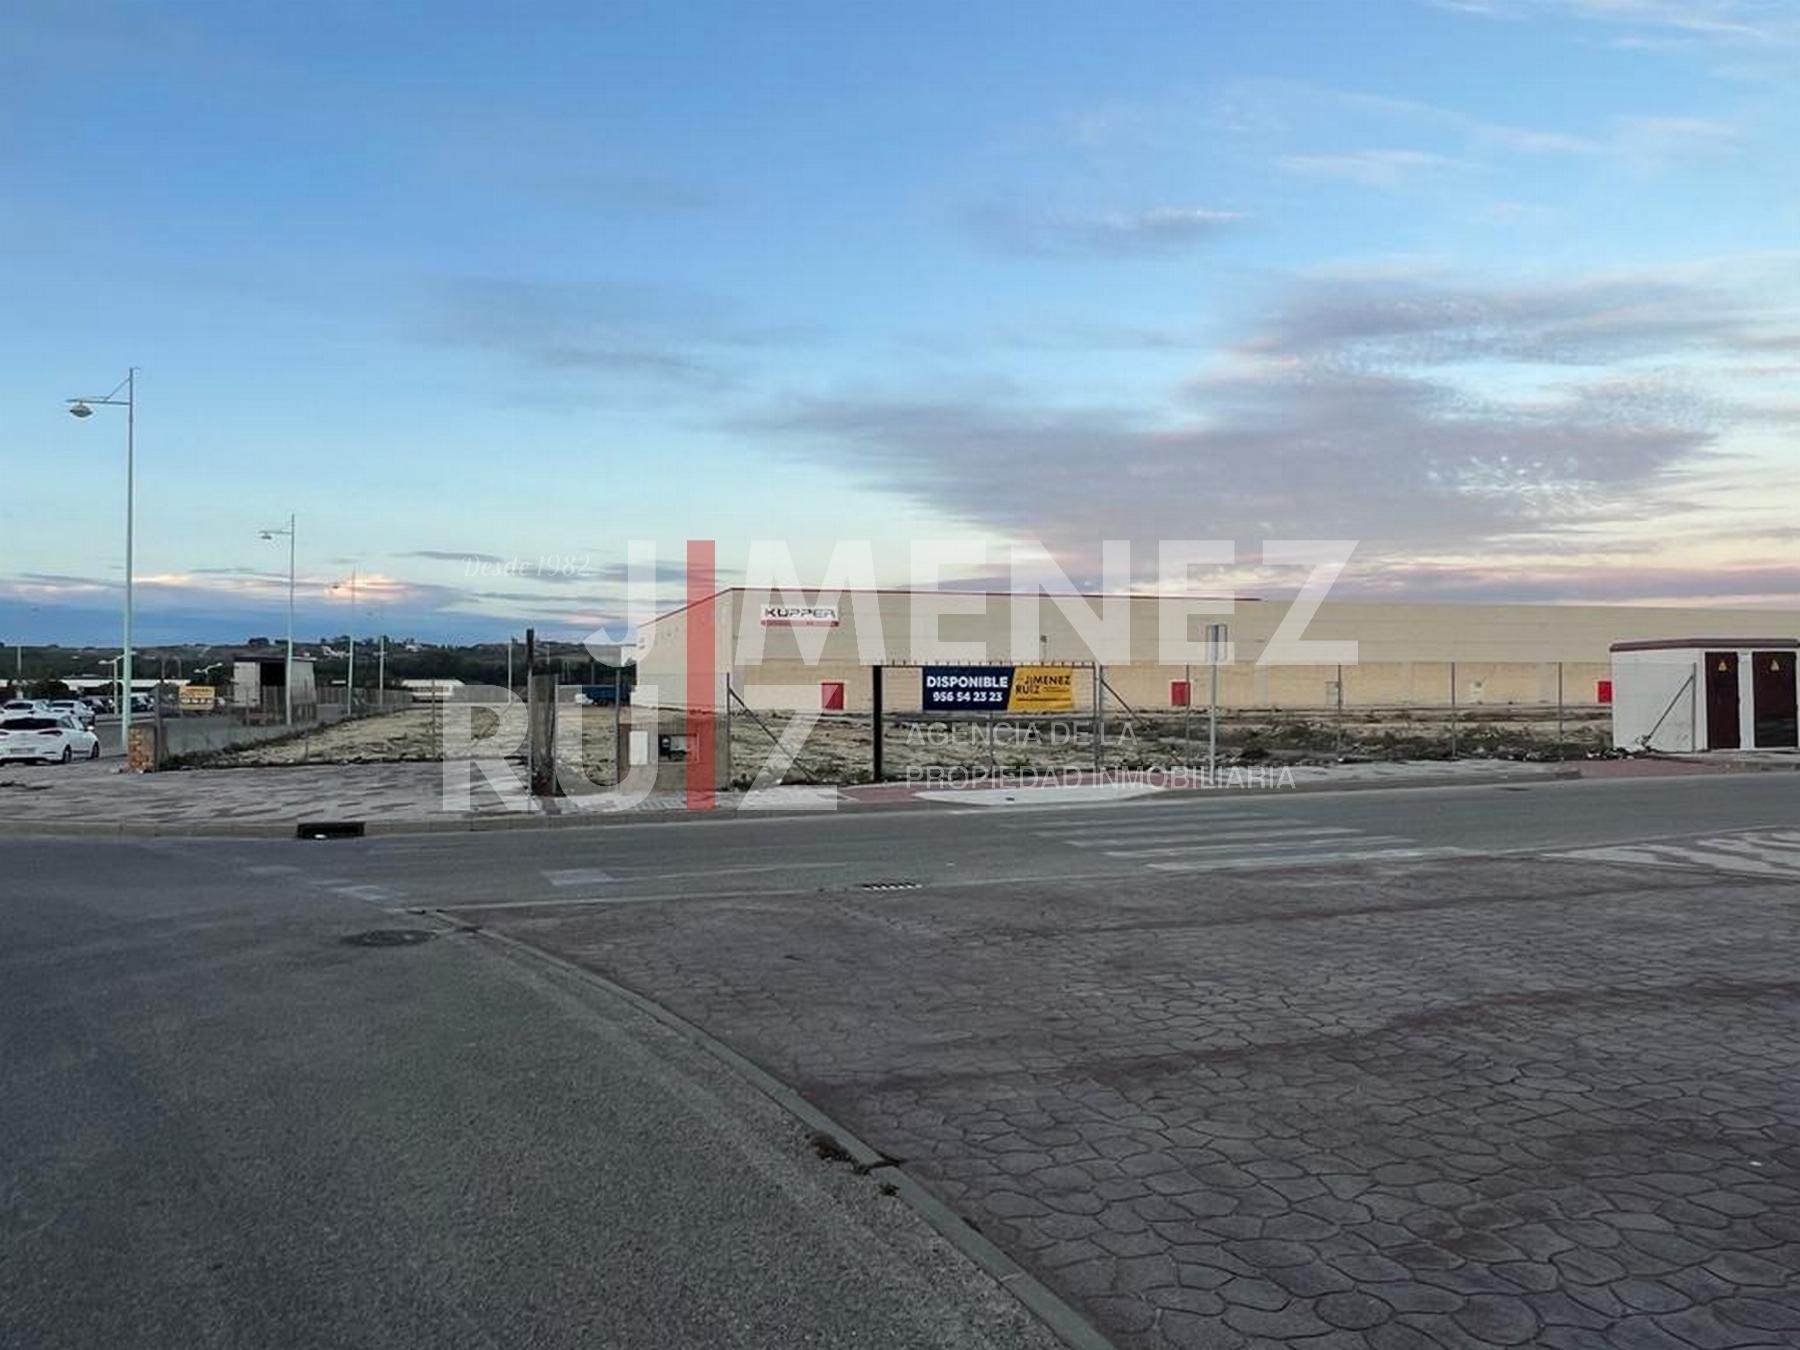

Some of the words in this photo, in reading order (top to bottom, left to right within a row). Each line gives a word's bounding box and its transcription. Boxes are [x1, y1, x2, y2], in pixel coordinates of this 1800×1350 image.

[926, 676, 1009, 688] DISPONIBLE
[1024, 675, 1071, 685] JIMENEZ
[1015, 684, 1040, 695] RUIZ
[933, 691, 954, 702] 956
[956, 691, 971, 702] 54
[973, 691, 987, 702] 23
[988, 691, 1003, 702] 23
